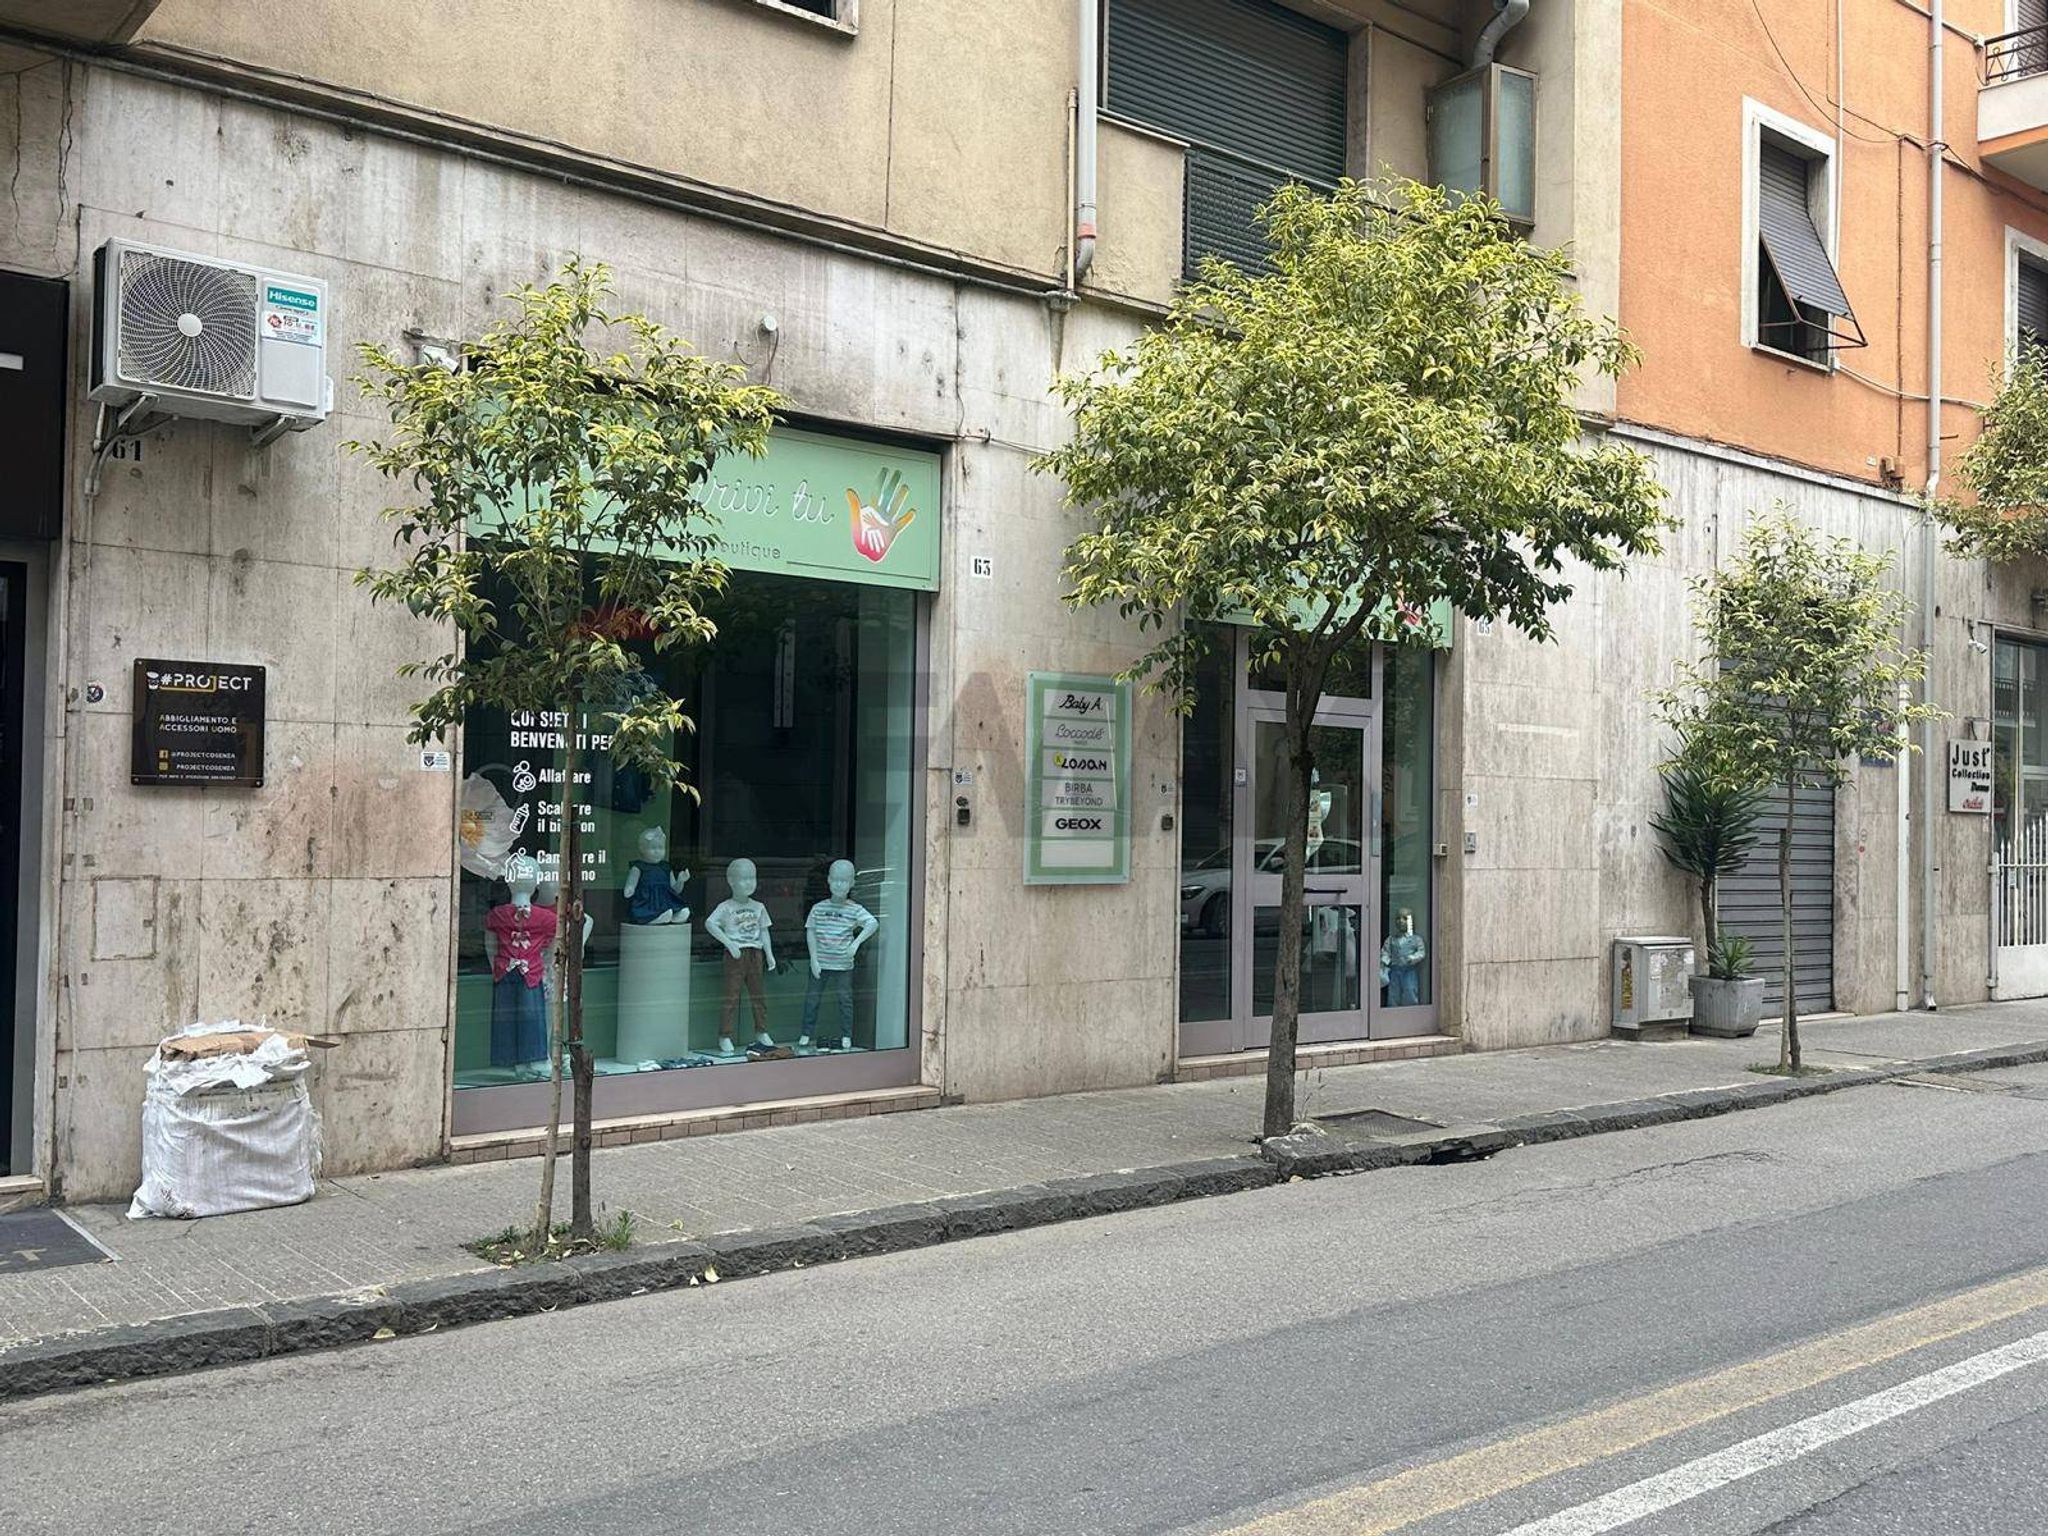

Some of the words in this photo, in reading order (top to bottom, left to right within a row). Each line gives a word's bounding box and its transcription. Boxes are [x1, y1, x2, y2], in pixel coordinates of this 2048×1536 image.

[113, 440, 141, 461] 61
[793, 480, 835, 524] tu
[720, 541, 781, 561] outique
[974, 558, 991, 576] 63
[160, 673, 252, 692] #PROJECT
[1059, 694, 1091, 715] Baby
[159, 714, 229, 725] ABBIGLIAMENTO
[159, 723, 209, 733] ACCESSORI
[211, 725, 237, 734] UOMO
[511, 731, 587, 750] BENVENTI
[539, 768, 592, 784] Allatare
[1065, 782, 1093, 794] BIRBA
[538, 800, 592, 816] Scalre
[549, 818, 596, 833] bion
[1055, 817, 1102, 830] GEOX
